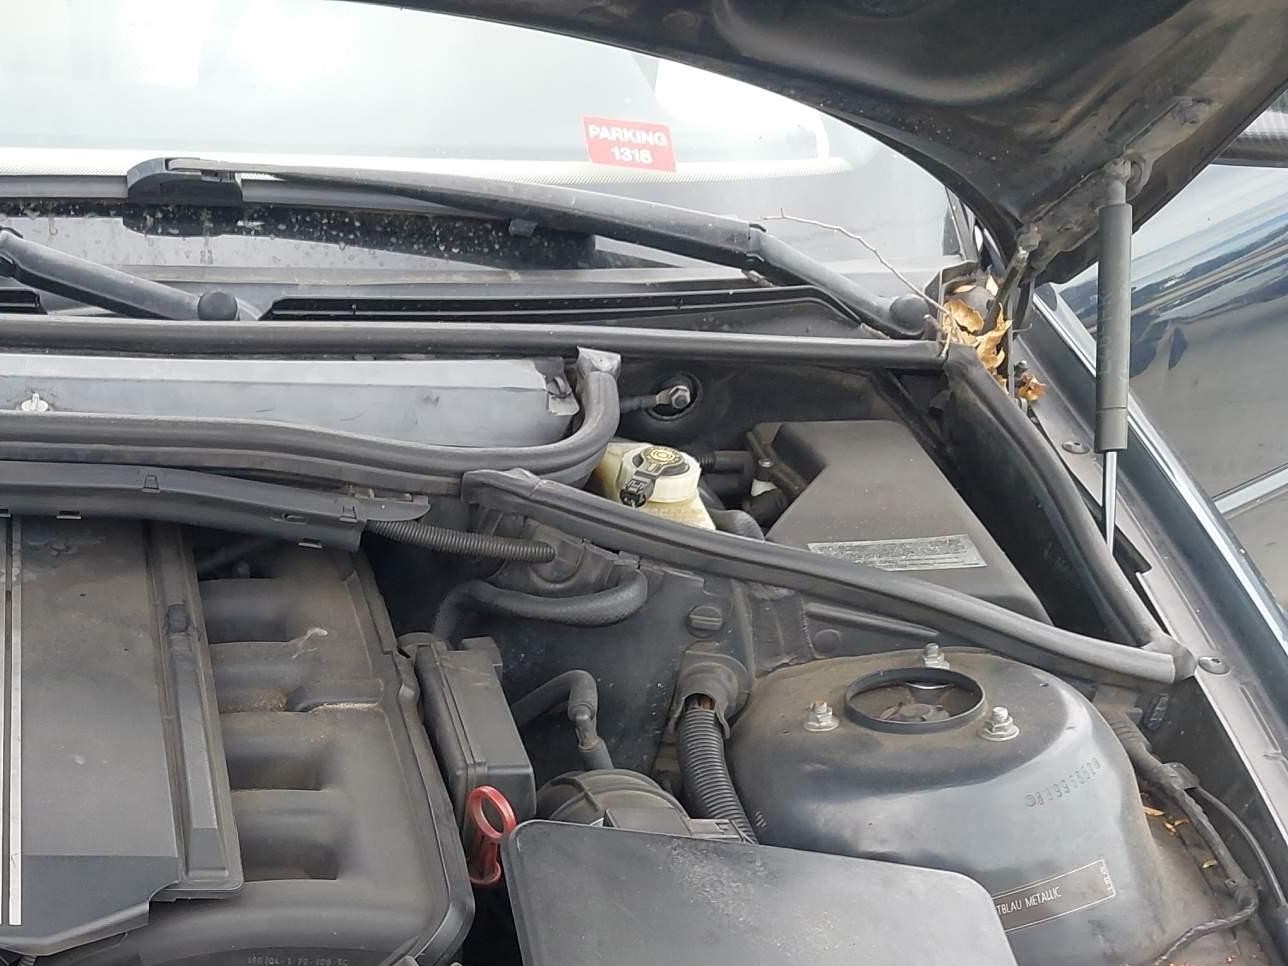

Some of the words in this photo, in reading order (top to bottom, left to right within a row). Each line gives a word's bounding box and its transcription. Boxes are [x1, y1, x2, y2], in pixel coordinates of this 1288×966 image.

[588, 124, 667, 146] PARKING
[611, 145, 653, 165] 1318
[1024, 886, 1062, 908] METALLIC
